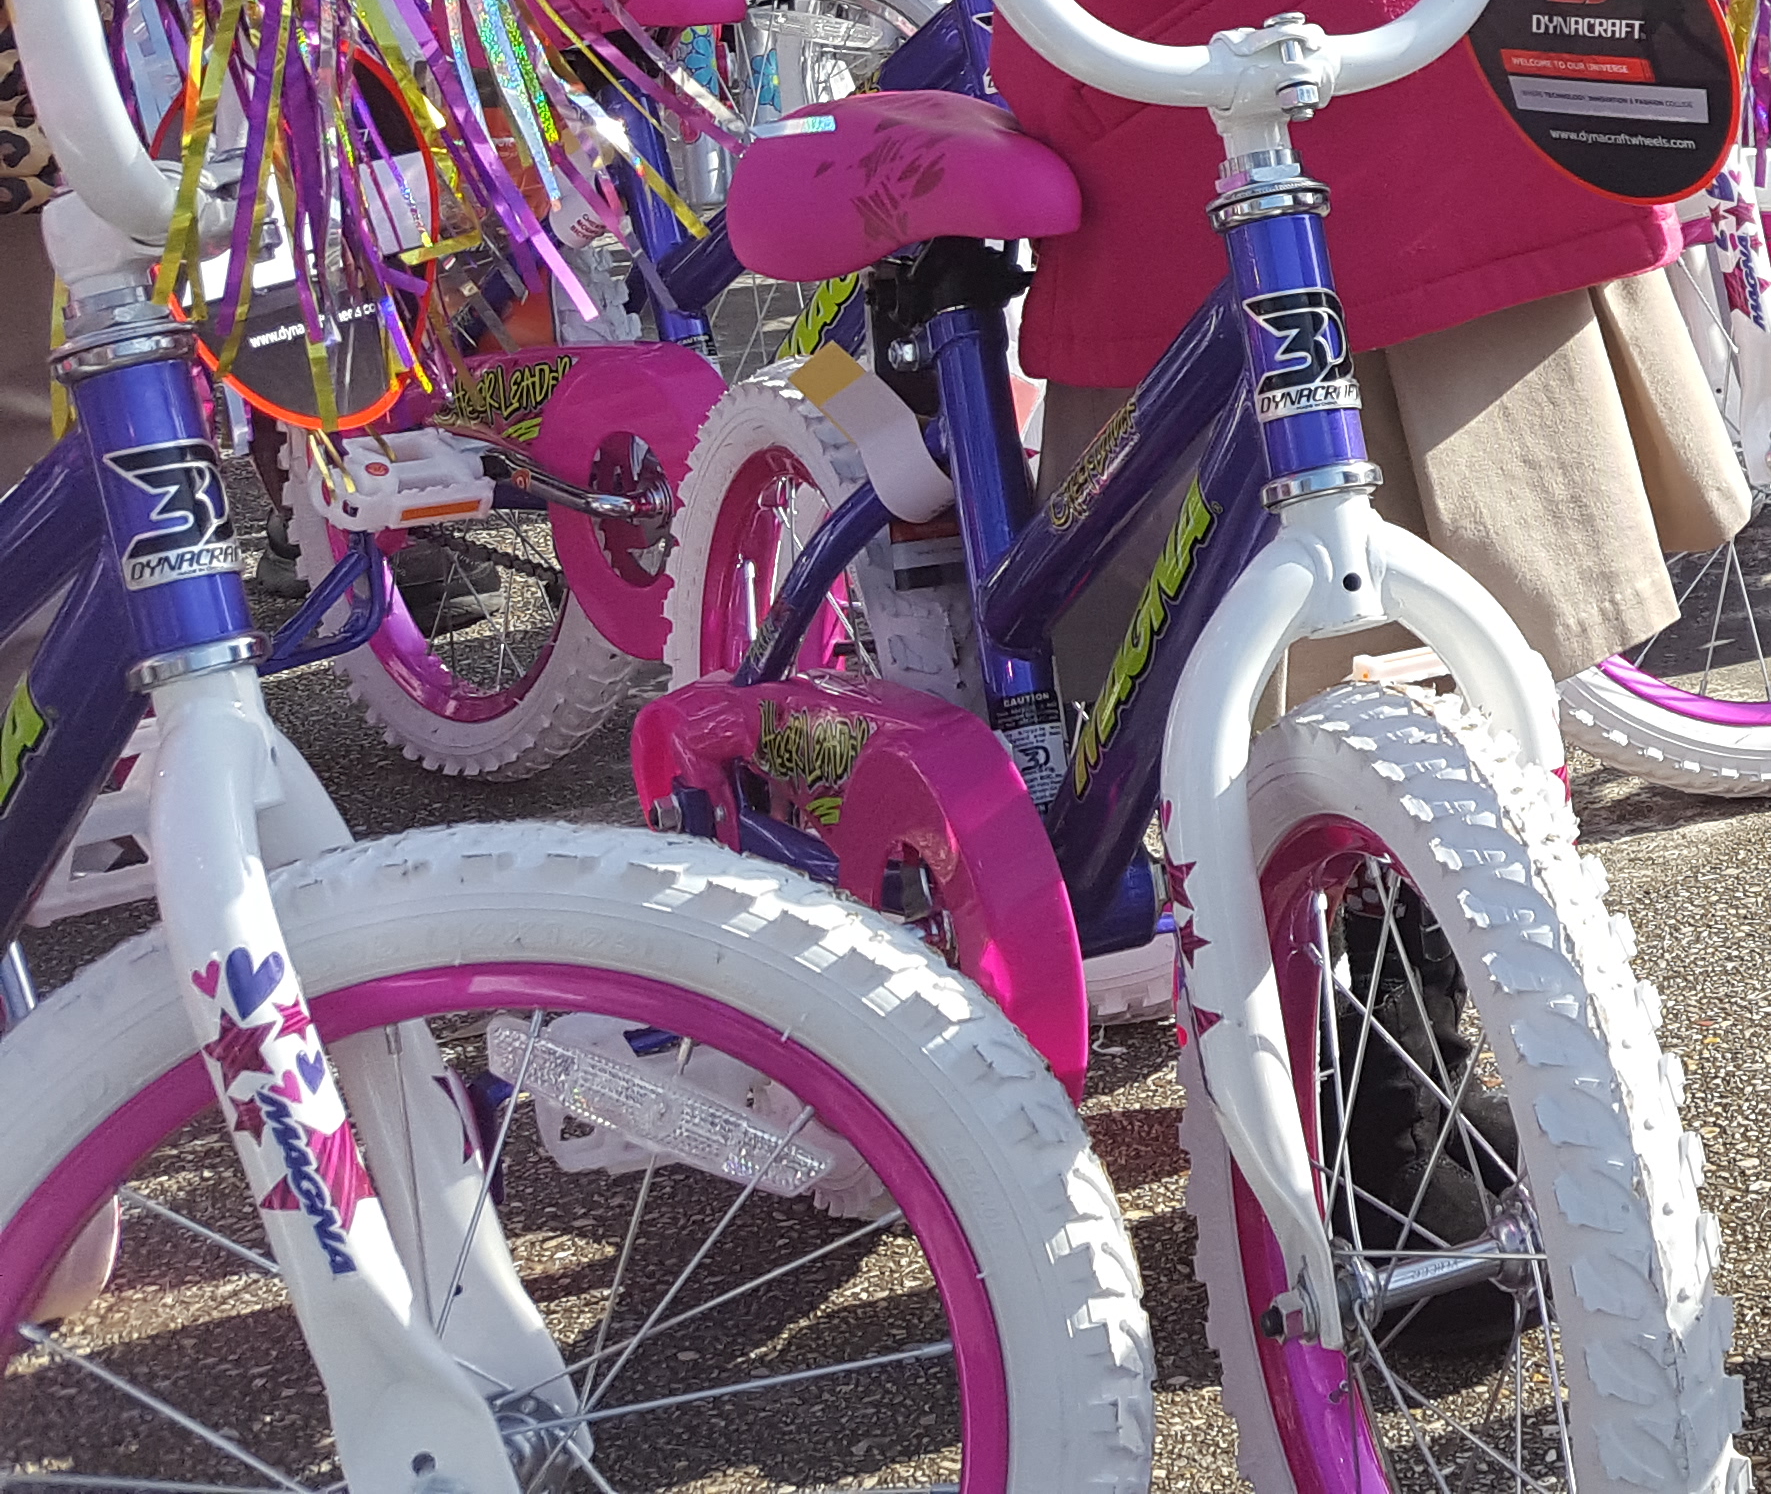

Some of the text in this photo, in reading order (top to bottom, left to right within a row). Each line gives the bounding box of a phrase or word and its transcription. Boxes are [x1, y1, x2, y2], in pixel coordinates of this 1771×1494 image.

[1531, 14, 1645, 40] DYNACRAFT
[1511, 56, 1629, 74] WELCOME TO OUR UNIVERSE
[1549, 129, 1696, 150] www.dynacraftwheels.com
[131, 544, 242, 581] DYNACRA
[1003, 691, 1050, 708] CAUTION
